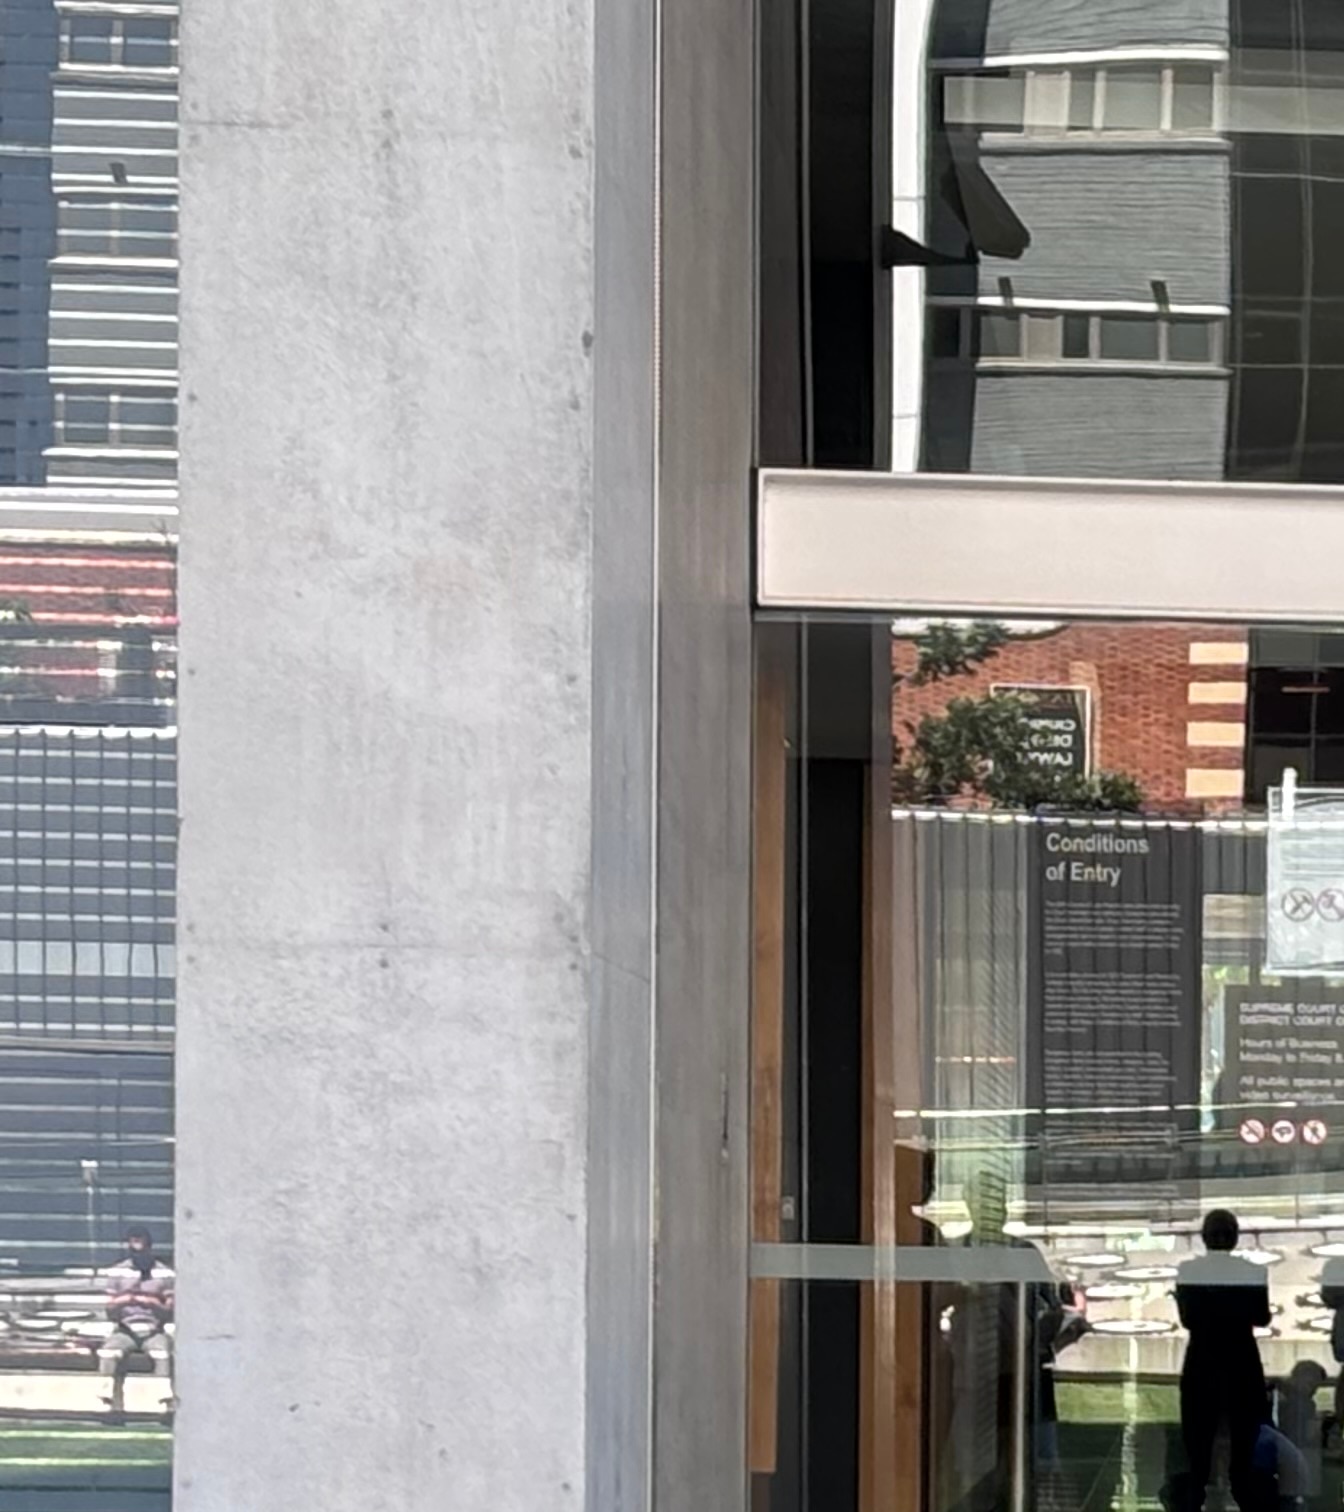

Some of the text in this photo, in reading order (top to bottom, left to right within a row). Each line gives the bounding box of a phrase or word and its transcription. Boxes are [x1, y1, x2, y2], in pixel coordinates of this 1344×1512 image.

[1046, 832, 1149, 853] Conditions
[1046, 861, 1121, 887] of Entry
[1239, 1003, 1294, 1014] SUPREME
[1297, 1003, 1336, 1015] COURT
[1239, 1015, 1290, 1026] DISTRICT
[1293, 1015, 1332, 1026] COURT
[1239, 1038, 1338, 1049] Hours of Business
[1239, 1052, 1282, 1065] Monday
[1286, 1052, 1297, 1063] to
[1300, 1052, 1332, 1065] Friday
[1239, 1075, 1254, 1086] All
[1257, 1075, 1289, 1088] public
[1293, 1077, 1331, 1088] spaces
[1239, 1090, 1269, 1100] video
